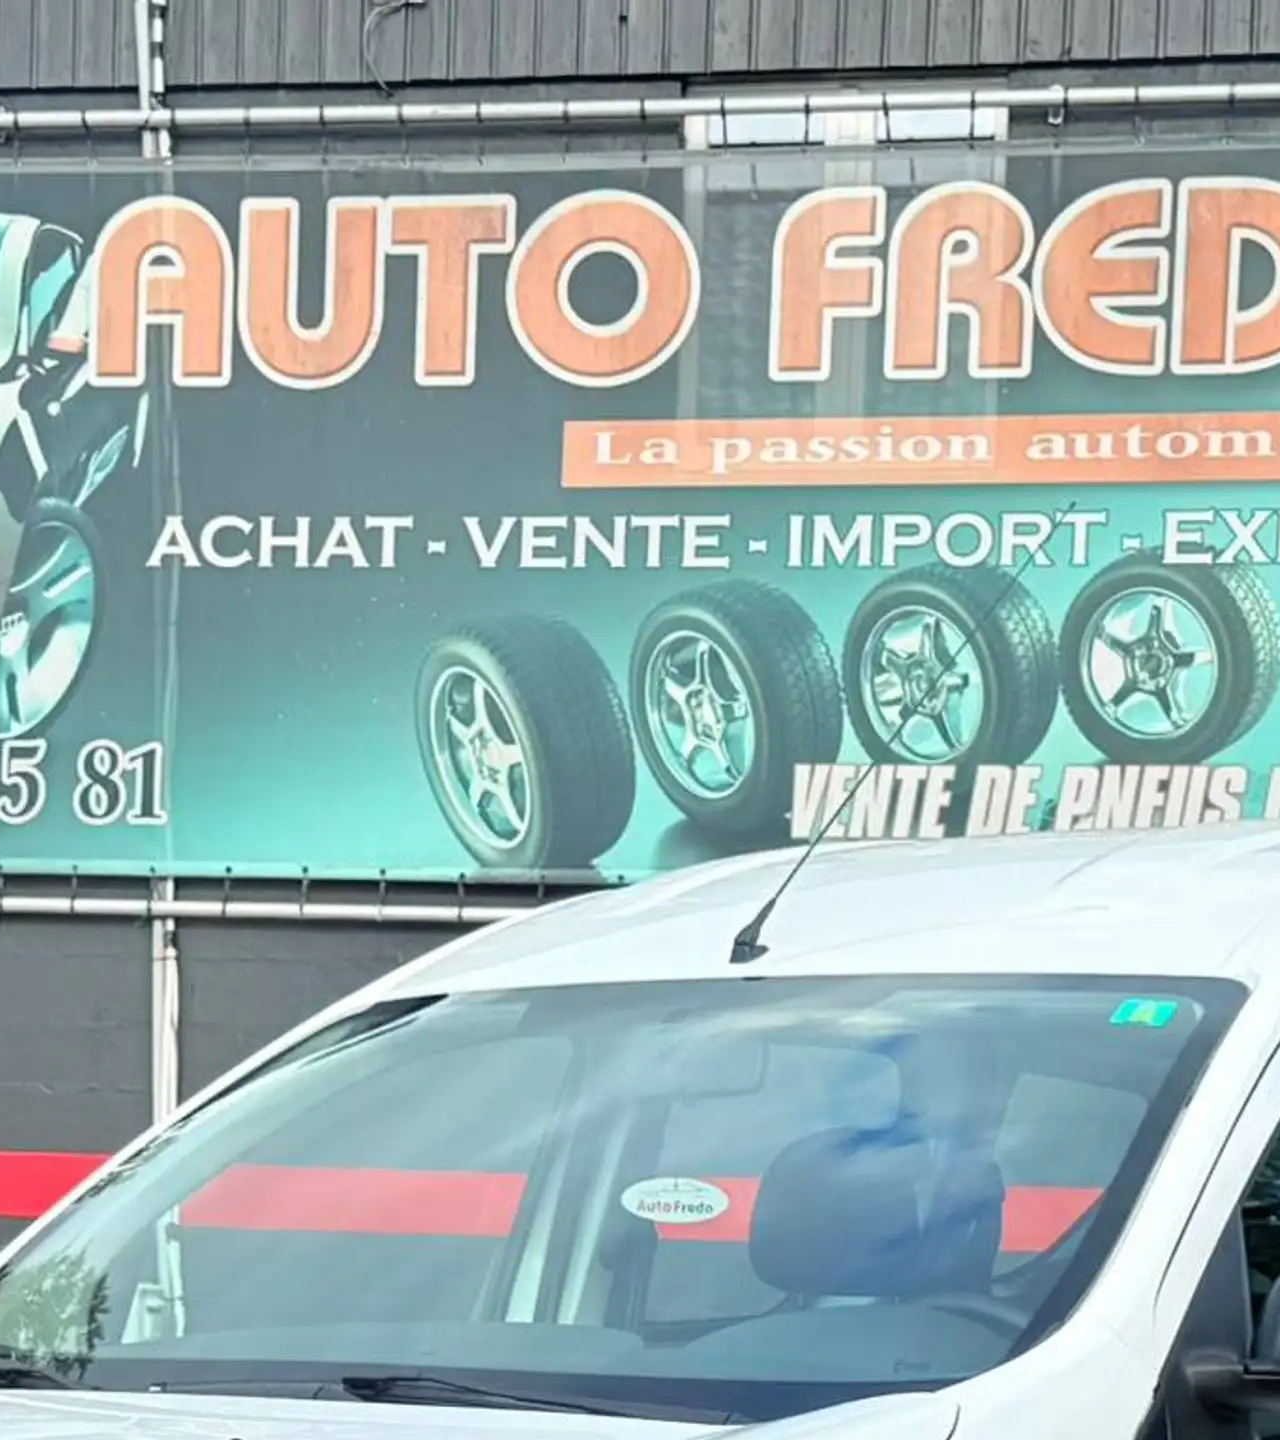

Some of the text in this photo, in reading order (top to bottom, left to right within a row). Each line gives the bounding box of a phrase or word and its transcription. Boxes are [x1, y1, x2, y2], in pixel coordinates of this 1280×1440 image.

[89, 189, 700, 388] AUTO
[593, 431, 678, 464] La
[713, 424, 993, 473] passion
[145, 515, 414, 568] ACHAT
[462, 514, 730, 568] VENTE
[786, 510, 1108, 569] IMPORT
[73, 740, 168, 825] 81
[790, 763, 957, 840] VENTE
[966, 763, 1045, 838] DE
